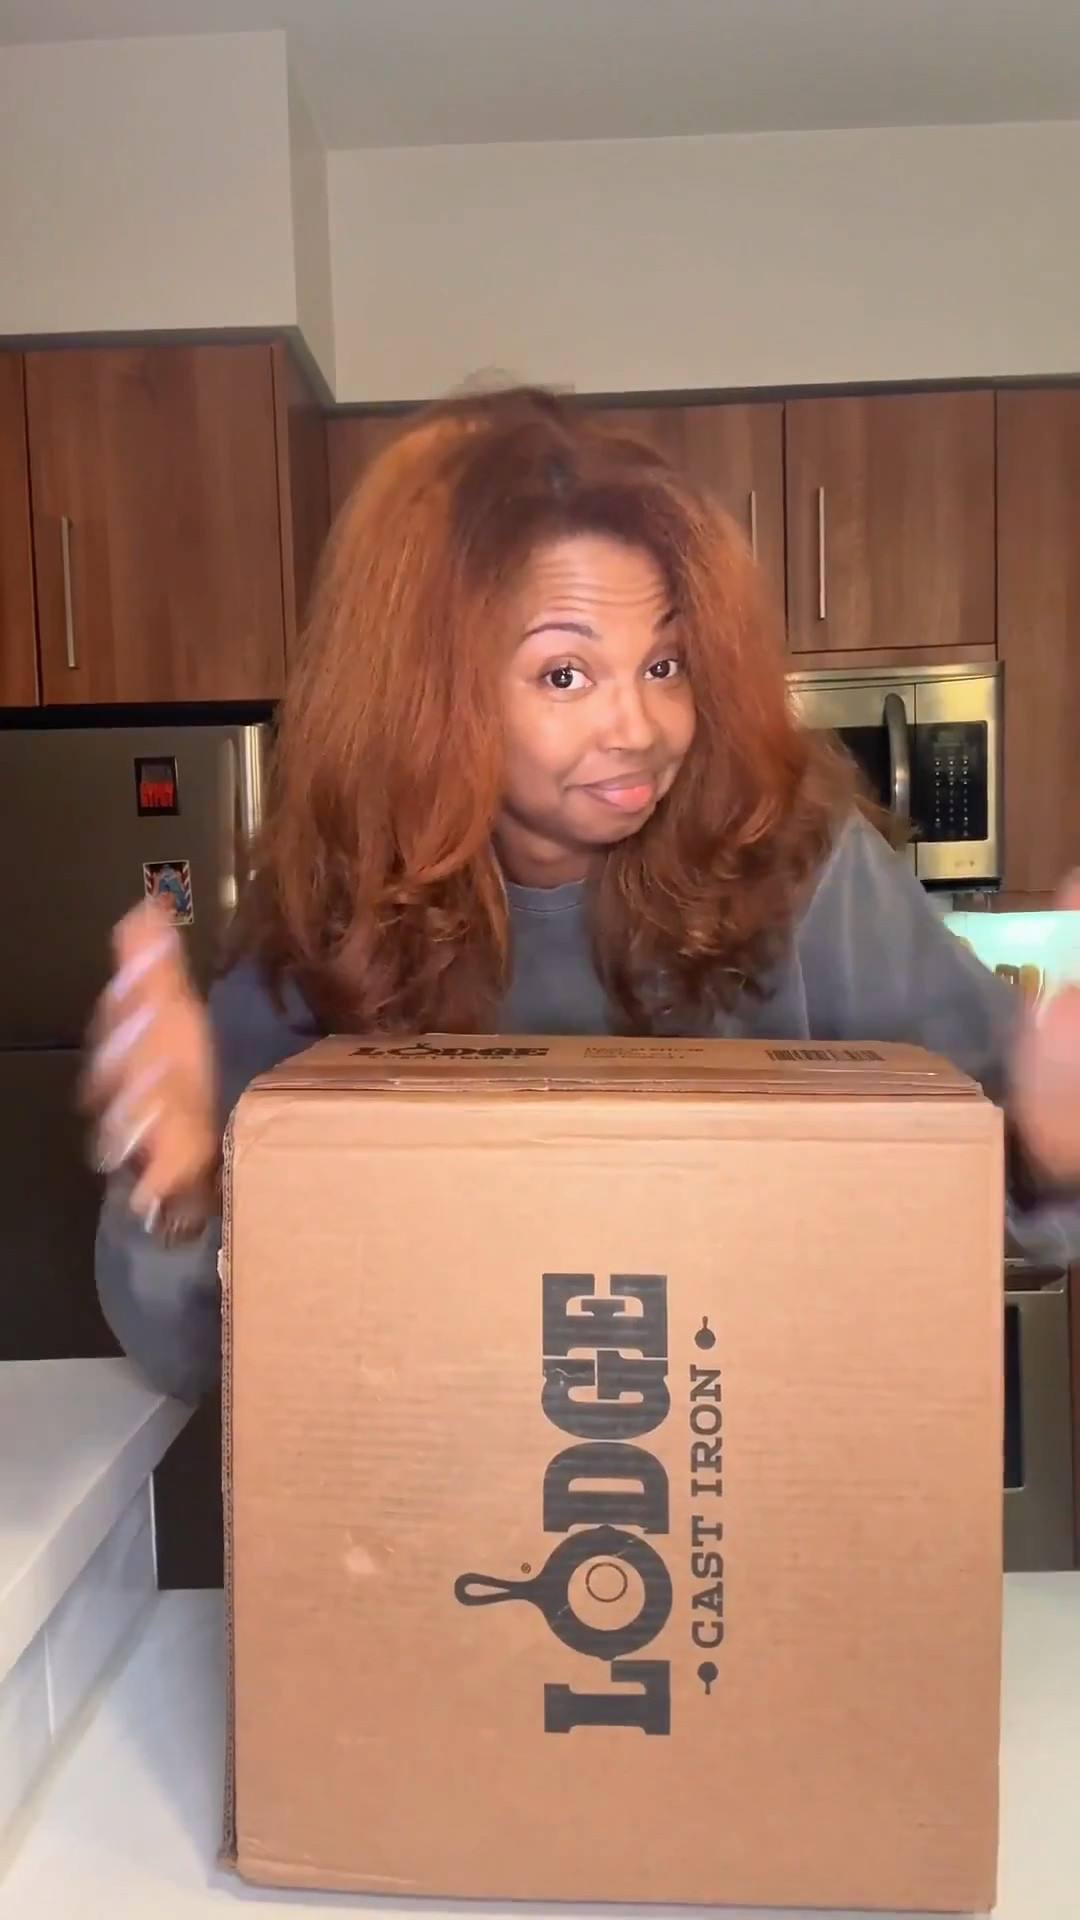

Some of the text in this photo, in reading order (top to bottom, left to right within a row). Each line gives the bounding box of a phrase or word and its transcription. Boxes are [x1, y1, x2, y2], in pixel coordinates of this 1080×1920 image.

[349, 1046, 549, 1057] LODGE
[541, 1273, 672, 1735] LODGE
[689, 1364, 725, 1649] CAST IRON
